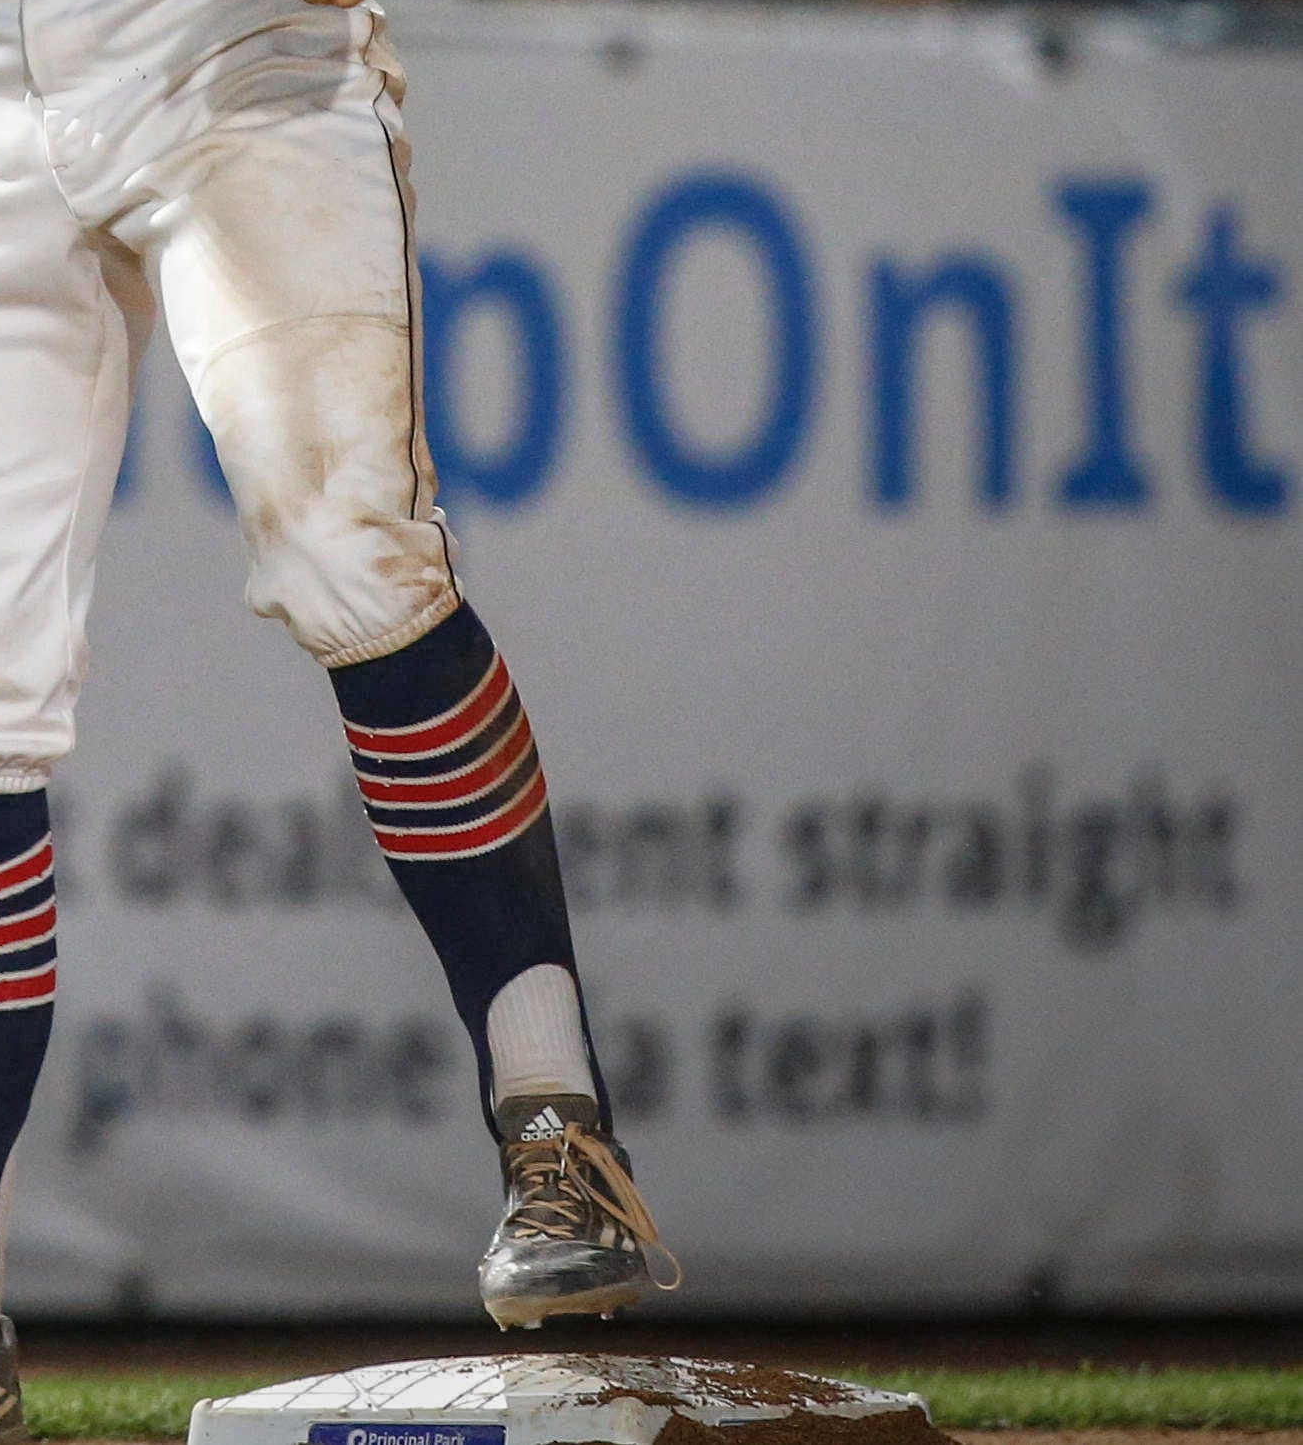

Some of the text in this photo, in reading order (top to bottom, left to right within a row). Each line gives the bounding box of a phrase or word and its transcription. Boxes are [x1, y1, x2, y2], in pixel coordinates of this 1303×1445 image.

[111, 165, 1286, 515] pOnIt
[108, 761, 404, 905] deal
[554, 787, 742, 907] ent
[787, 762, 1240, 953] straight
[68, 987, 451, 1155] phone
[712, 993, 988, 1121] text!
[521, 1127, 565, 1142] adid
